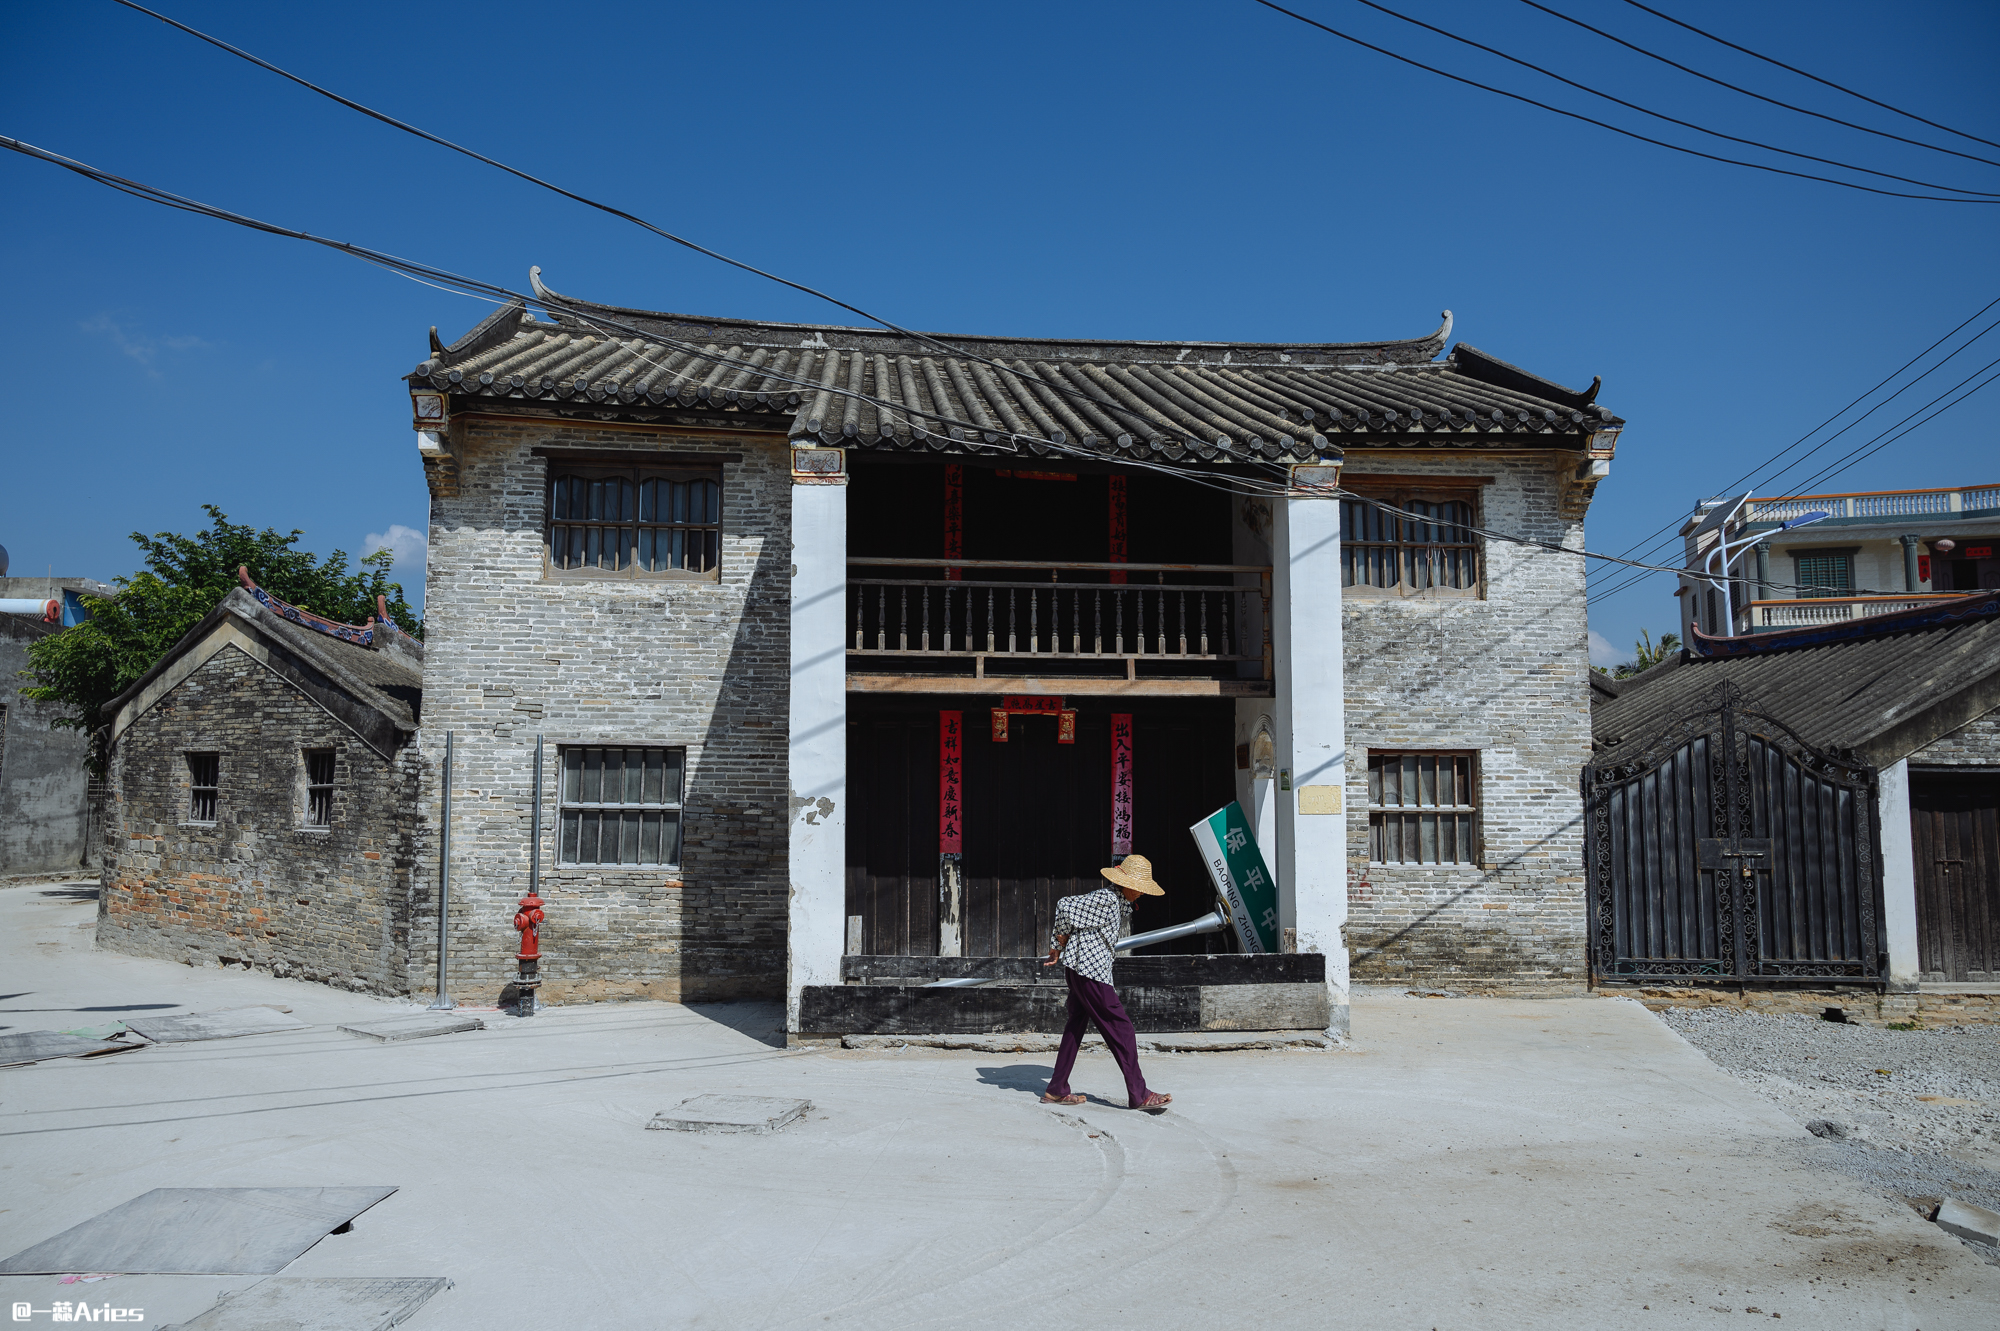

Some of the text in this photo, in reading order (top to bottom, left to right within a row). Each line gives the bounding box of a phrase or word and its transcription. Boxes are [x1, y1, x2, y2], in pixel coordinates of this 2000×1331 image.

[942, 719, 960, 838] 吉祥如意慶新春
[1213, 858, 1260, 953] BAOPING ZHONG
[1223, 826, 1277, 932] 保平中
